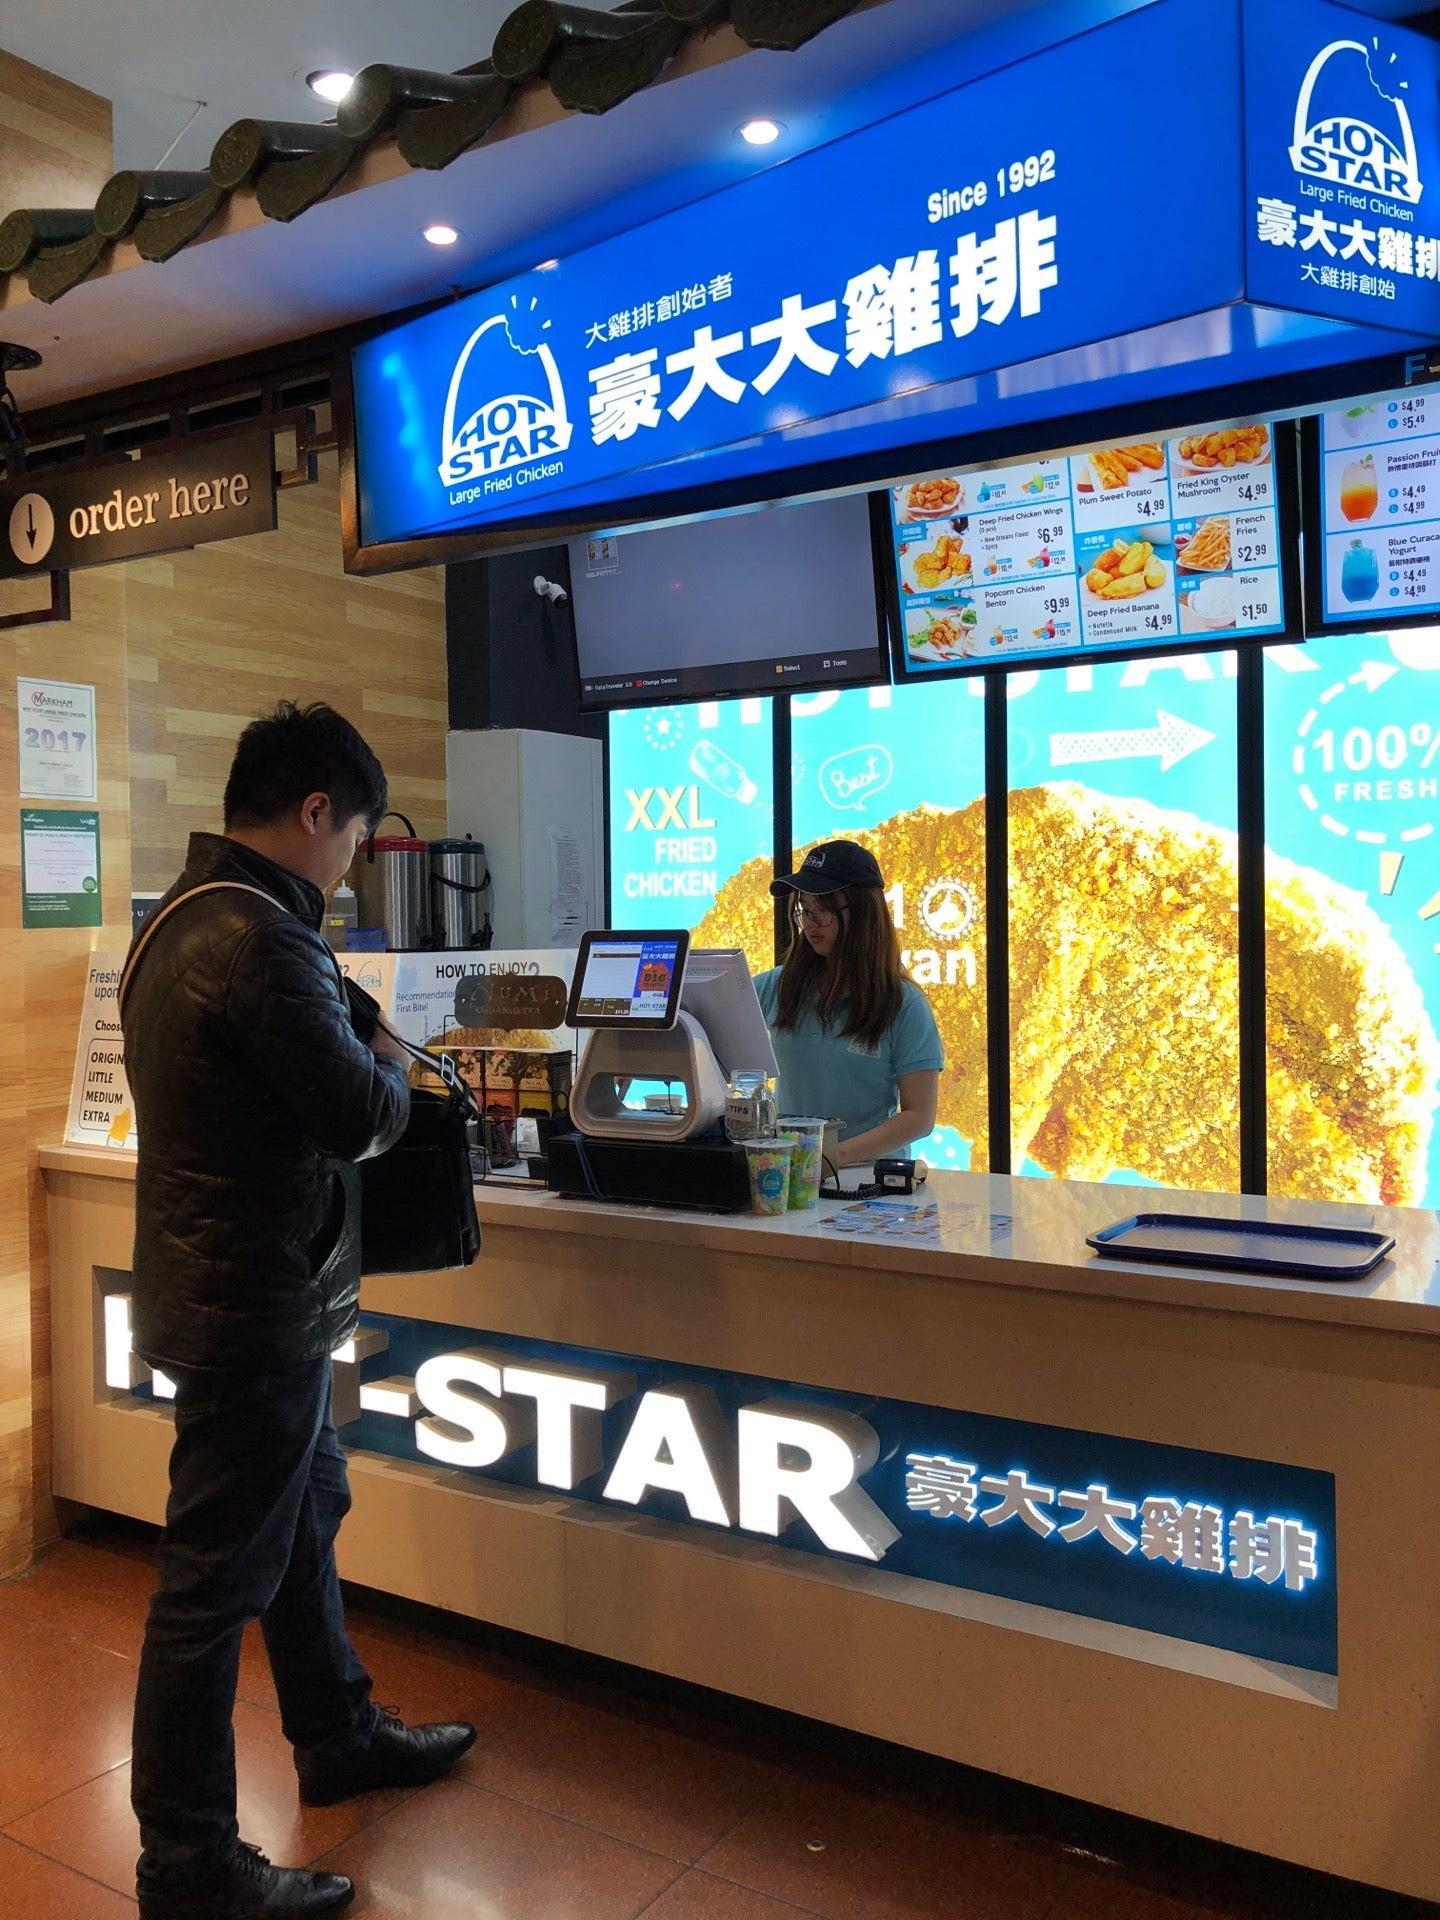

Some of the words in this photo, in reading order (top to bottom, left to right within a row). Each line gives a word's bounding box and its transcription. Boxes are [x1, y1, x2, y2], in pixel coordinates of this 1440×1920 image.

[1313, 122, 1400, 164] HOT
[1300, 146, 1410, 198] STAR
[926, 176, 988, 225] Since
[996, 150, 1056, 200] 1992
[1300, 180, 1333, 203] Large
[1337, 190, 1367, 210] Fried
[1370, 198, 1414, 222] Chicken
[585, 273, 734, 349] 大雞排創始者
[588, 210, 1059, 444] 豪大大雞排
[1401, 398, 1425, 412] $4.99
[460, 400, 540, 449] HOT
[1402, 415, 1425, 429] $5.49
[448, 427, 562, 481] STAR
[1387, 453, 1419, 464] Passion
[449, 482, 482, 507] Large
[483, 473, 514, 498] Fried
[516, 460, 564, 492] Chicken
[1177, 480, 1198, 490] Fried
[1200, 478, 1219, 489] King
[1221, 472, 1250, 484] Oyster
[1079, 496, 1098, 506] Plum
[1100, 493, 1124, 503] Sweet
[1126, 488, 1152, 498] Potato
[1177, 486, 1221, 499] Mushroom
[1238, 483, 1267, 502] $4.99
[1402, 485, 1425, 498] $4.49
[69, 489, 160, 539] order
[169, 473, 250, 519] here
[1137, 499, 1164, 517] $4.99
[1403, 501, 1425, 514] $4.99
[979, 518, 997, 528] Deep
[997, 514, 1014, 523] Fried
[1016, 509, 1043, 520] Chicken
[1044, 506, 1064, 517] Wings
[1235, 515, 1266, 525] French
[1015, 531, 1030, 539] Flavor
[1038, 526, 1064, 544] $6.99
[1236, 526, 1257, 536] Fries
[985, 543, 998, 551] Spicy
[1388, 537, 1407, 547] Blue
[1409, 534, 1440, 545] Curaca
[1238, 544, 1267, 562] $2.99
[1388, 546, 1417, 556] Yogurt
[1240, 575, 1258, 585] Rice
[1403, 569, 1427, 582] $4.49
[985, 589, 1015, 599] Popcorn
[1016, 585, 1045, 595] Chicken
[1404, 585, 1426, 597] $4.99
[985, 600, 1007, 608] Bento
[1044, 597, 1070, 614] $9.99
[1087, 608, 1108, 619] Deep
[1110, 606, 1131, 615] Fried
[1132, 602, 1160, 612] Banana
[1241, 603, 1268, 620] $1.50
[1092, 621, 1113, 630] Nutella
[1093, 627, 1123, 636] Condensed
[1125, 625, 1138, 633] Milk
[1145, 614, 1172, 631] $4.99
[783, 664, 801, 672] Select
[642, 679, 660, 687] Change
[660, 677, 677, 685] Device
[32, 692, 73, 708] MARKHAM
[24, 727, 87, 752] 2017
[1312, 721, 1440, 772] 100%
[829, 754, 880, 798] Best
[1333, 777, 1437, 803] FRESH
[624, 784, 717, 832] XXL
[654, 836, 717, 865] FRIED
[624, 870, 717, 898] CHICKEN
[436, 964, 466, 979] HOW
[470, 963, 486, 976] TO
[396, 1004, 411, 1013] First
[95, 1019, 122, 1032] Choos
[91, 1051, 124, 1065] ORIGIN
[88, 1071, 113, 1084] LITTLE
[85, 1091, 123, 1105] MEDIUM
[82, 1110, 111, 1123] EXTRA
[729, 1105, 749, 1115] TIPS
[905, 1453, 1318, 1592] 豪大大雞排
